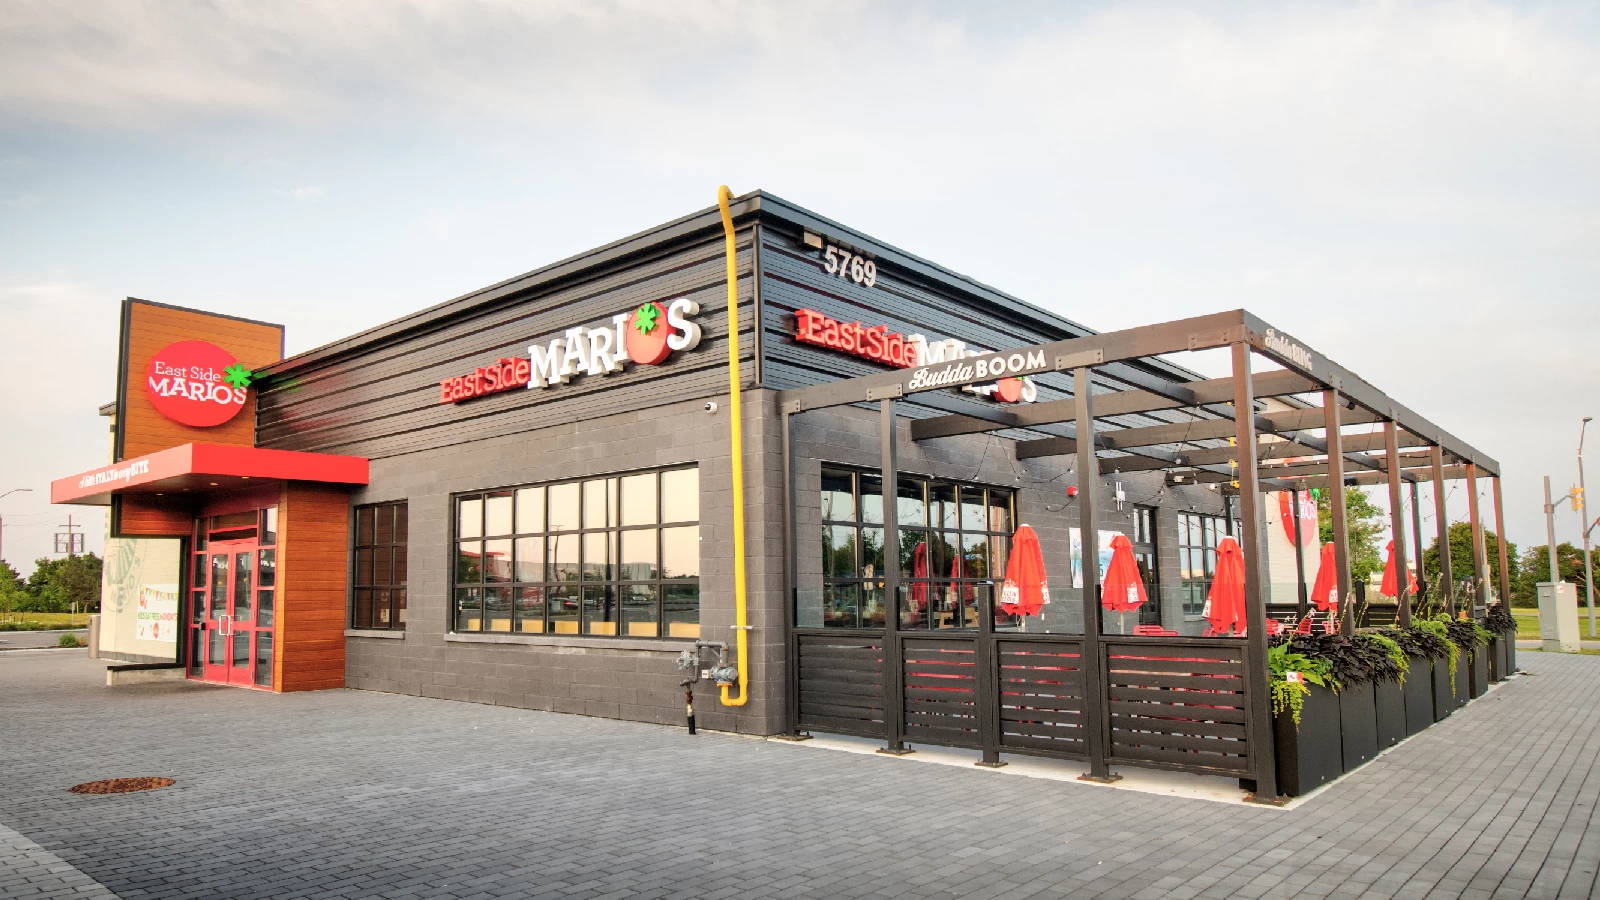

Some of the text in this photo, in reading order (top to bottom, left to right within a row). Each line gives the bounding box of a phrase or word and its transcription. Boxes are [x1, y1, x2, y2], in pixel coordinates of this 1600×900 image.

[824, 245, 877, 288] 5769
[155, 361, 222, 382] East Side
[908, 349, 1047, 390] Budda BOOM
[130, 459, 149, 477] BITE
